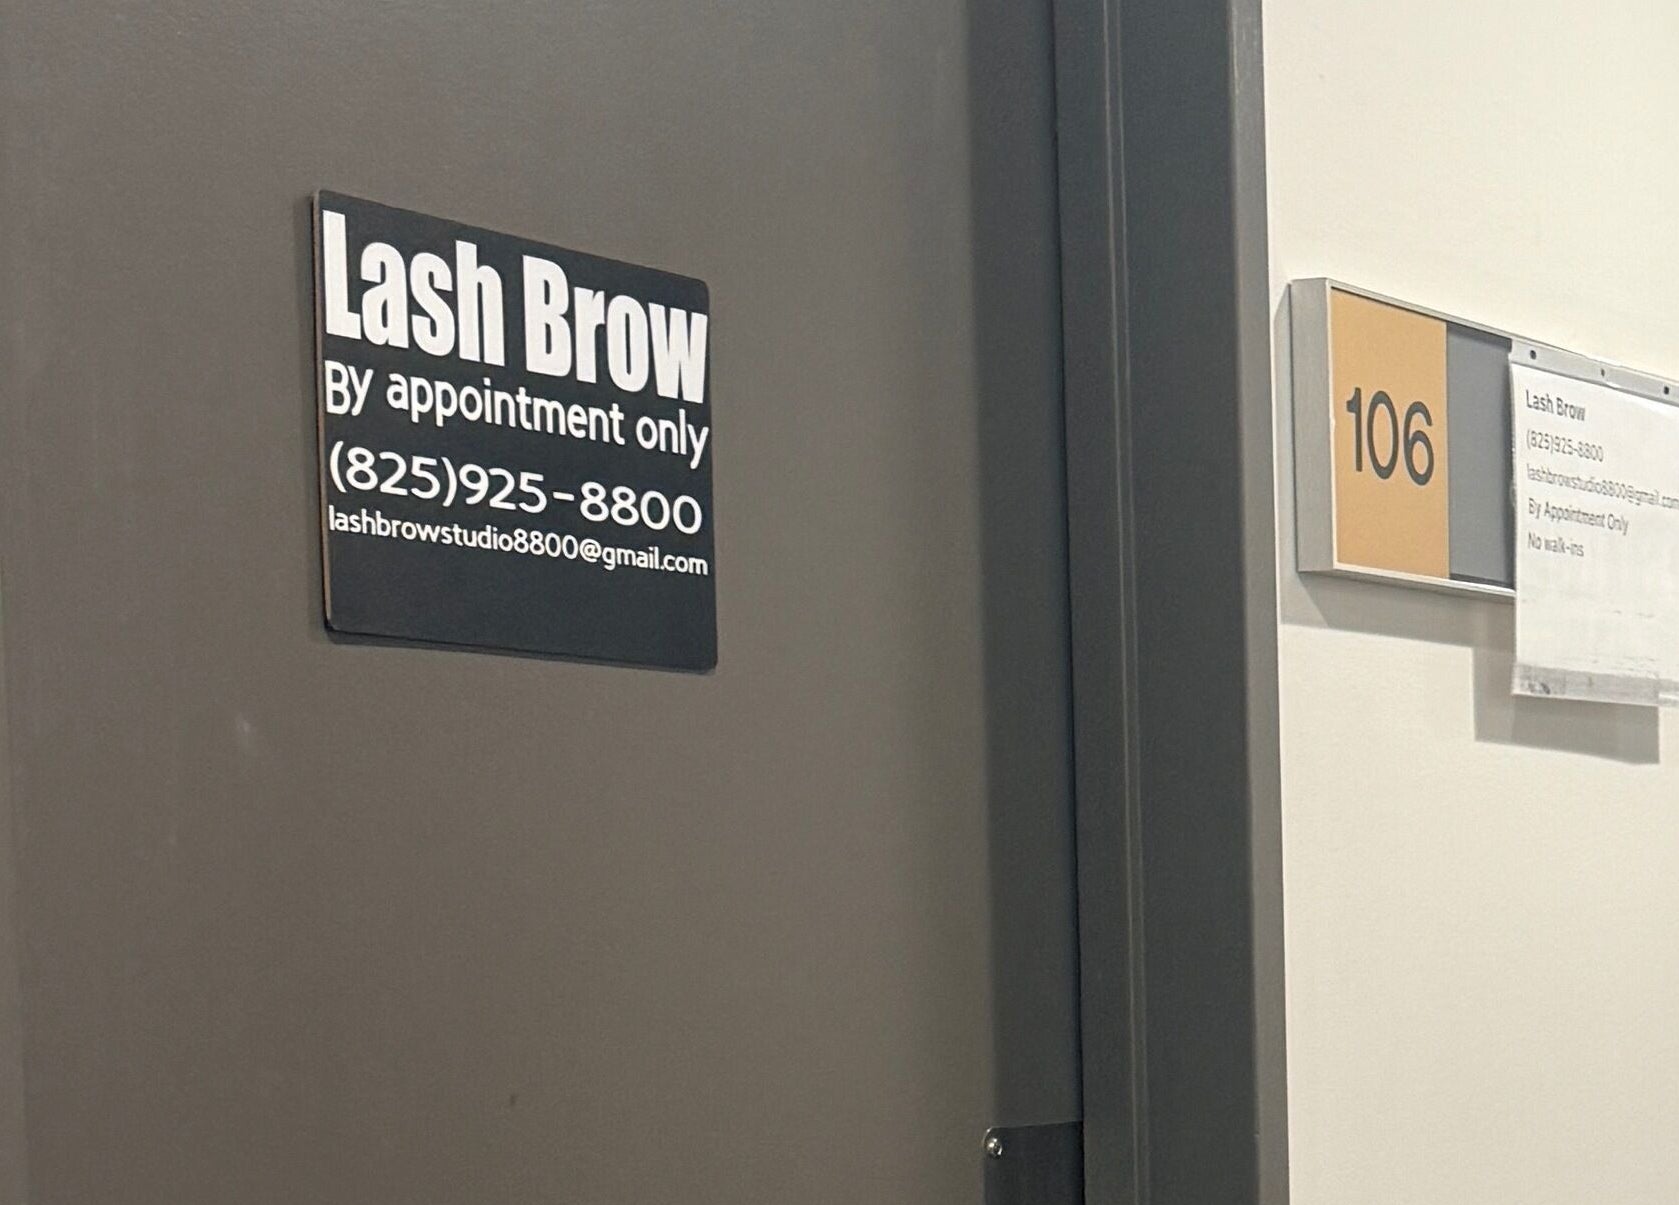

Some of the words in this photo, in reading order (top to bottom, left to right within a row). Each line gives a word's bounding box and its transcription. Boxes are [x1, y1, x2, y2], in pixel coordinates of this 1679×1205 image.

[323, 210, 505, 366] Lash
[522, 254, 708, 404] Brow
[324, 360, 373, 416] By
[386, 372, 625, 445] appointment
[636, 409, 709, 469] only
[1346, 387, 1434, 486] 106
[1526, 390, 1553, 415] Lash
[1556, 396, 1586, 421] Brow
[1526, 430, 1603, 462] (825)925-8800
[329, 441, 702, 535] (825)925-8800
[1528, 498, 1541, 520] By
[1543, 500, 1605, 529] Appointment
[1607, 512, 1629, 536] Only
[329, 506, 709, 576] lashbrowstudio8800@gmail.com
[1528, 532, 1542, 551] No
